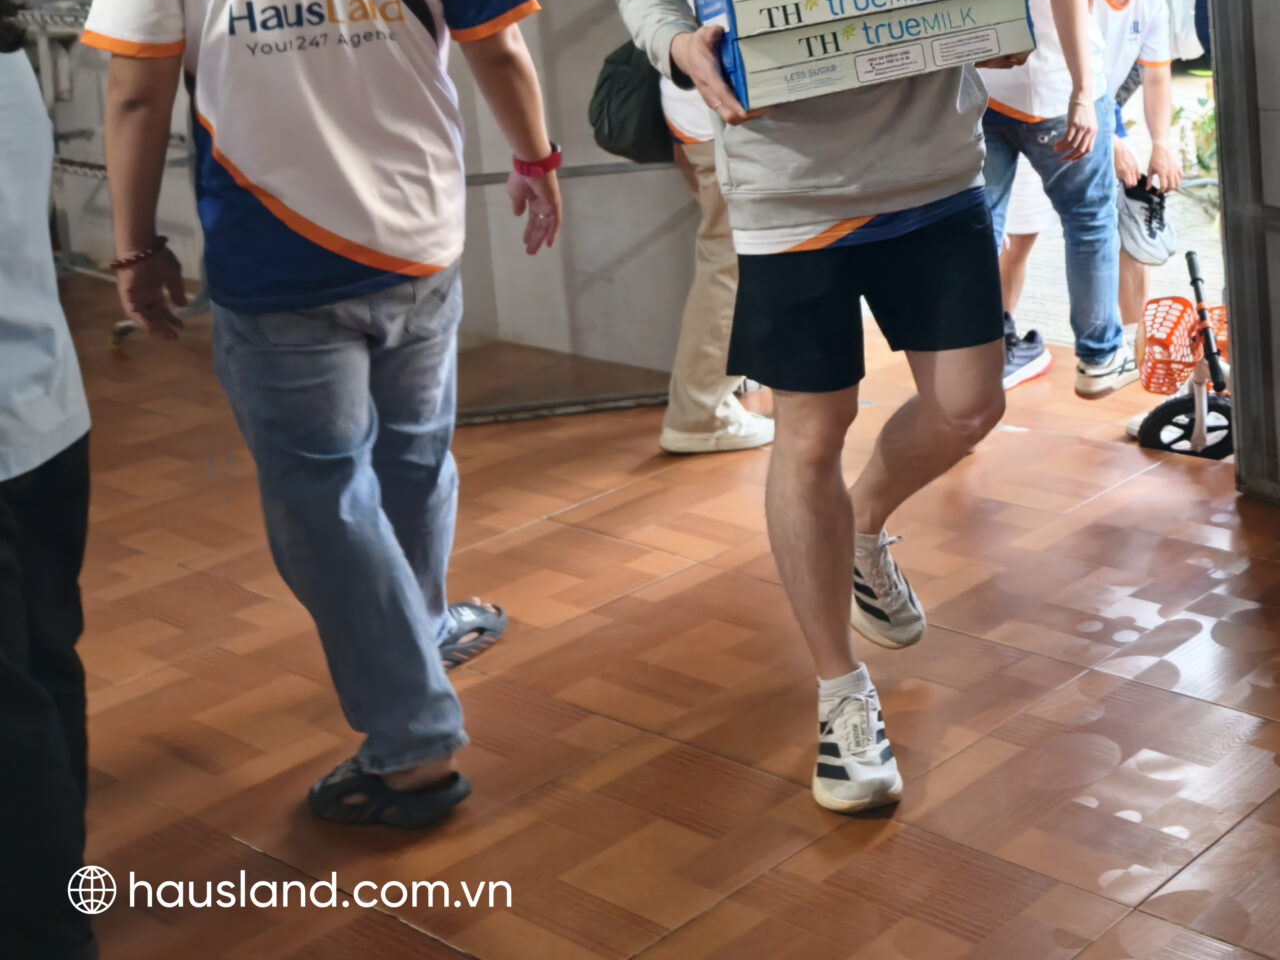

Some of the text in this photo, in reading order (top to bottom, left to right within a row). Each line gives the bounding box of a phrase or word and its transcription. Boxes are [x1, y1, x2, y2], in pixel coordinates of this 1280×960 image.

[759, 1, 804, 29] TH
[297, 33, 329, 51] 247
[798, 31, 842, 58] TH
